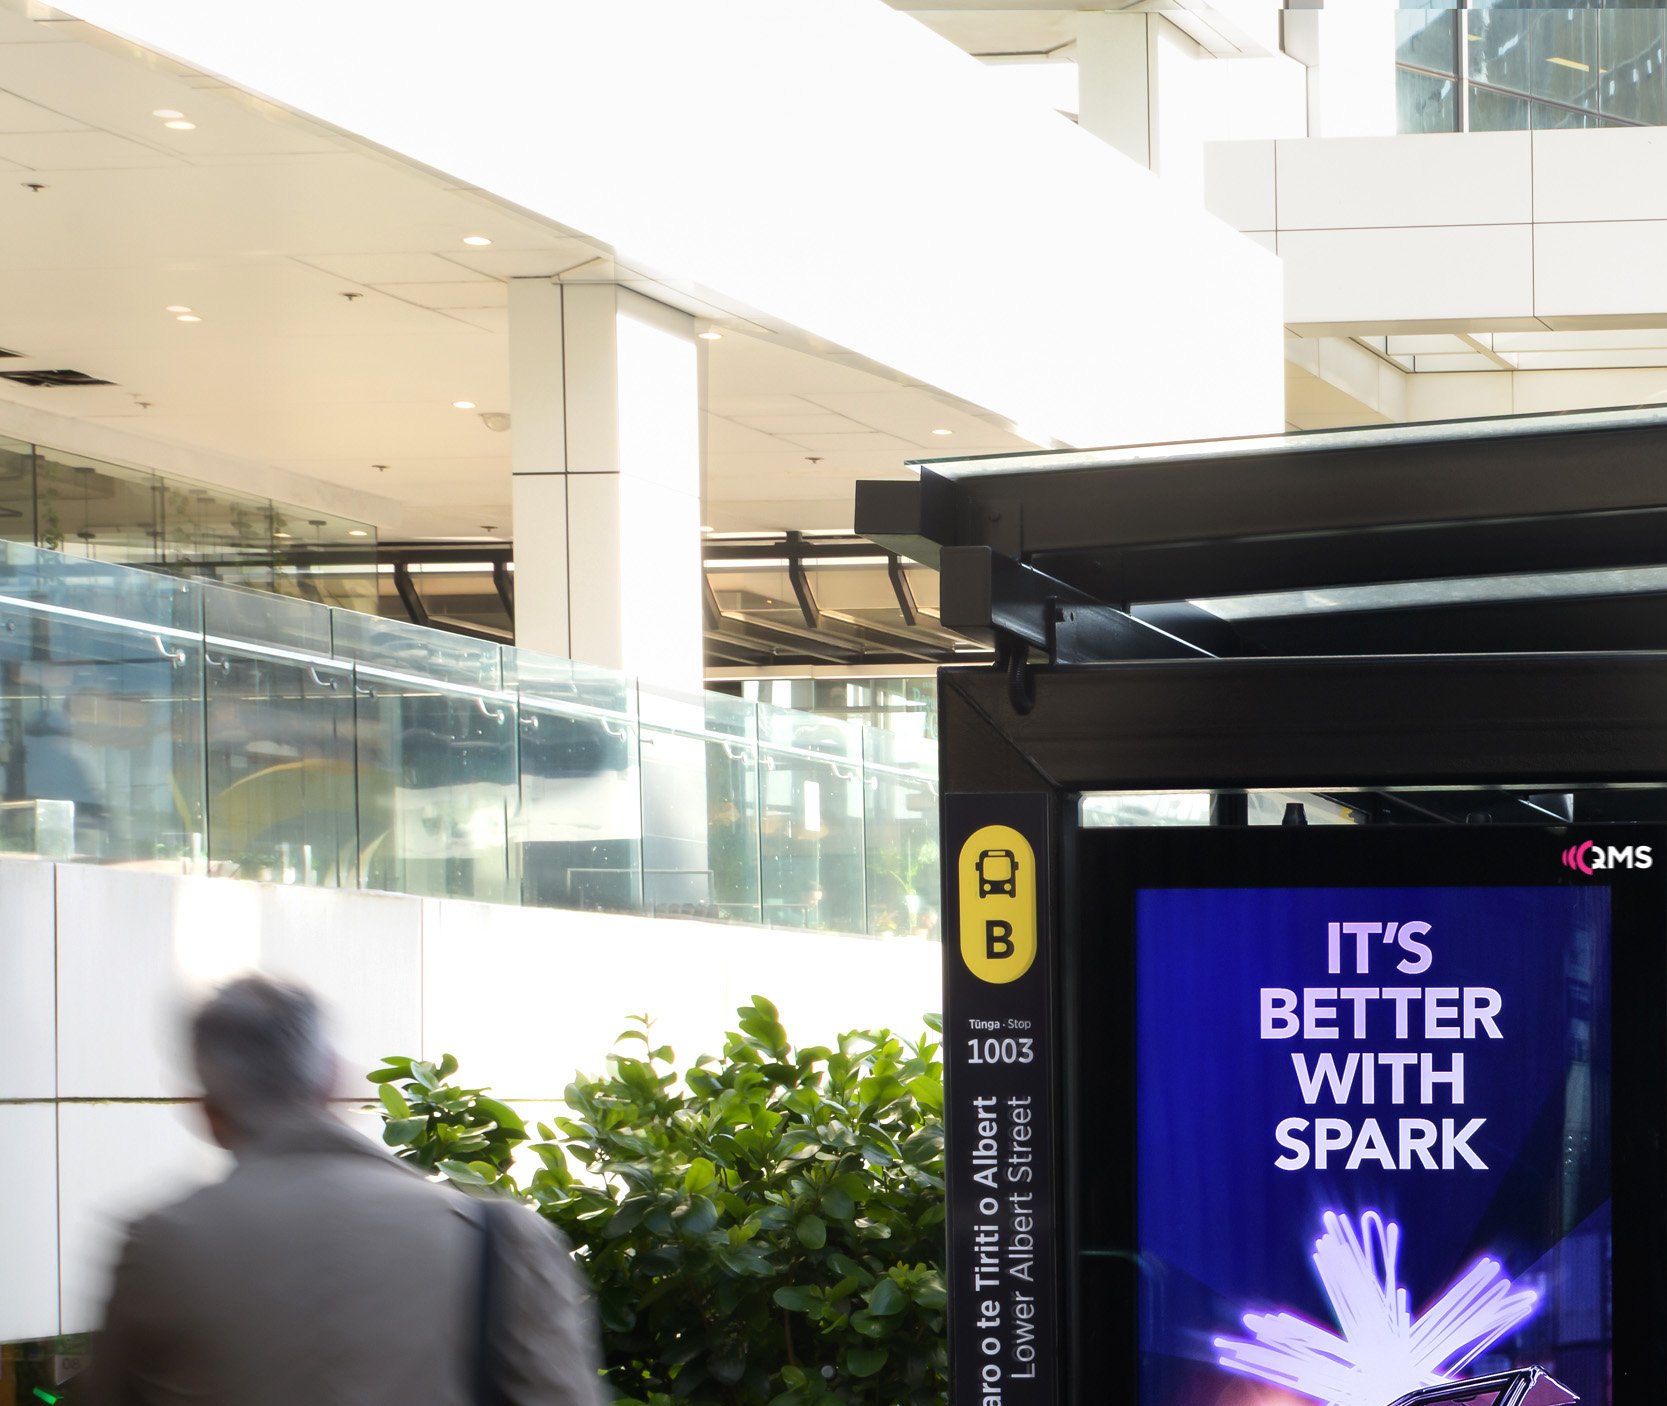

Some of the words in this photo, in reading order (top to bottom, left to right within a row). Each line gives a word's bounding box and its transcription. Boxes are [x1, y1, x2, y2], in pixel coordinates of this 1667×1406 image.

[1576, 840, 1654, 875] QMS
[985, 919, 1015, 960] B
[1327, 921, 1433, 976] IT'S
[968, 1018, 1001, 1031] Tūnga
[1007, 1018, 1032, 1031] Stop
[1259, 987, 1504, 1040] BETTER
[967, 1038, 1034, 1064] 1003
[1290, 1053, 1466, 1105] WITH
[972, 1095, 998, 1189] Albert
[1007, 1095, 1033, 1183] Street
[1273, 1117, 1490, 1173] SPARK
[979, 1197, 999, 1216] o
[973, 1224, 1000, 1292] Tiriti
[1008, 1192, 1034, 1282] Albert
[976, 1300, 1001, 1329] te
[1010, 1291, 1036, 1380] Lower
[980, 1337, 1002, 1356] o
